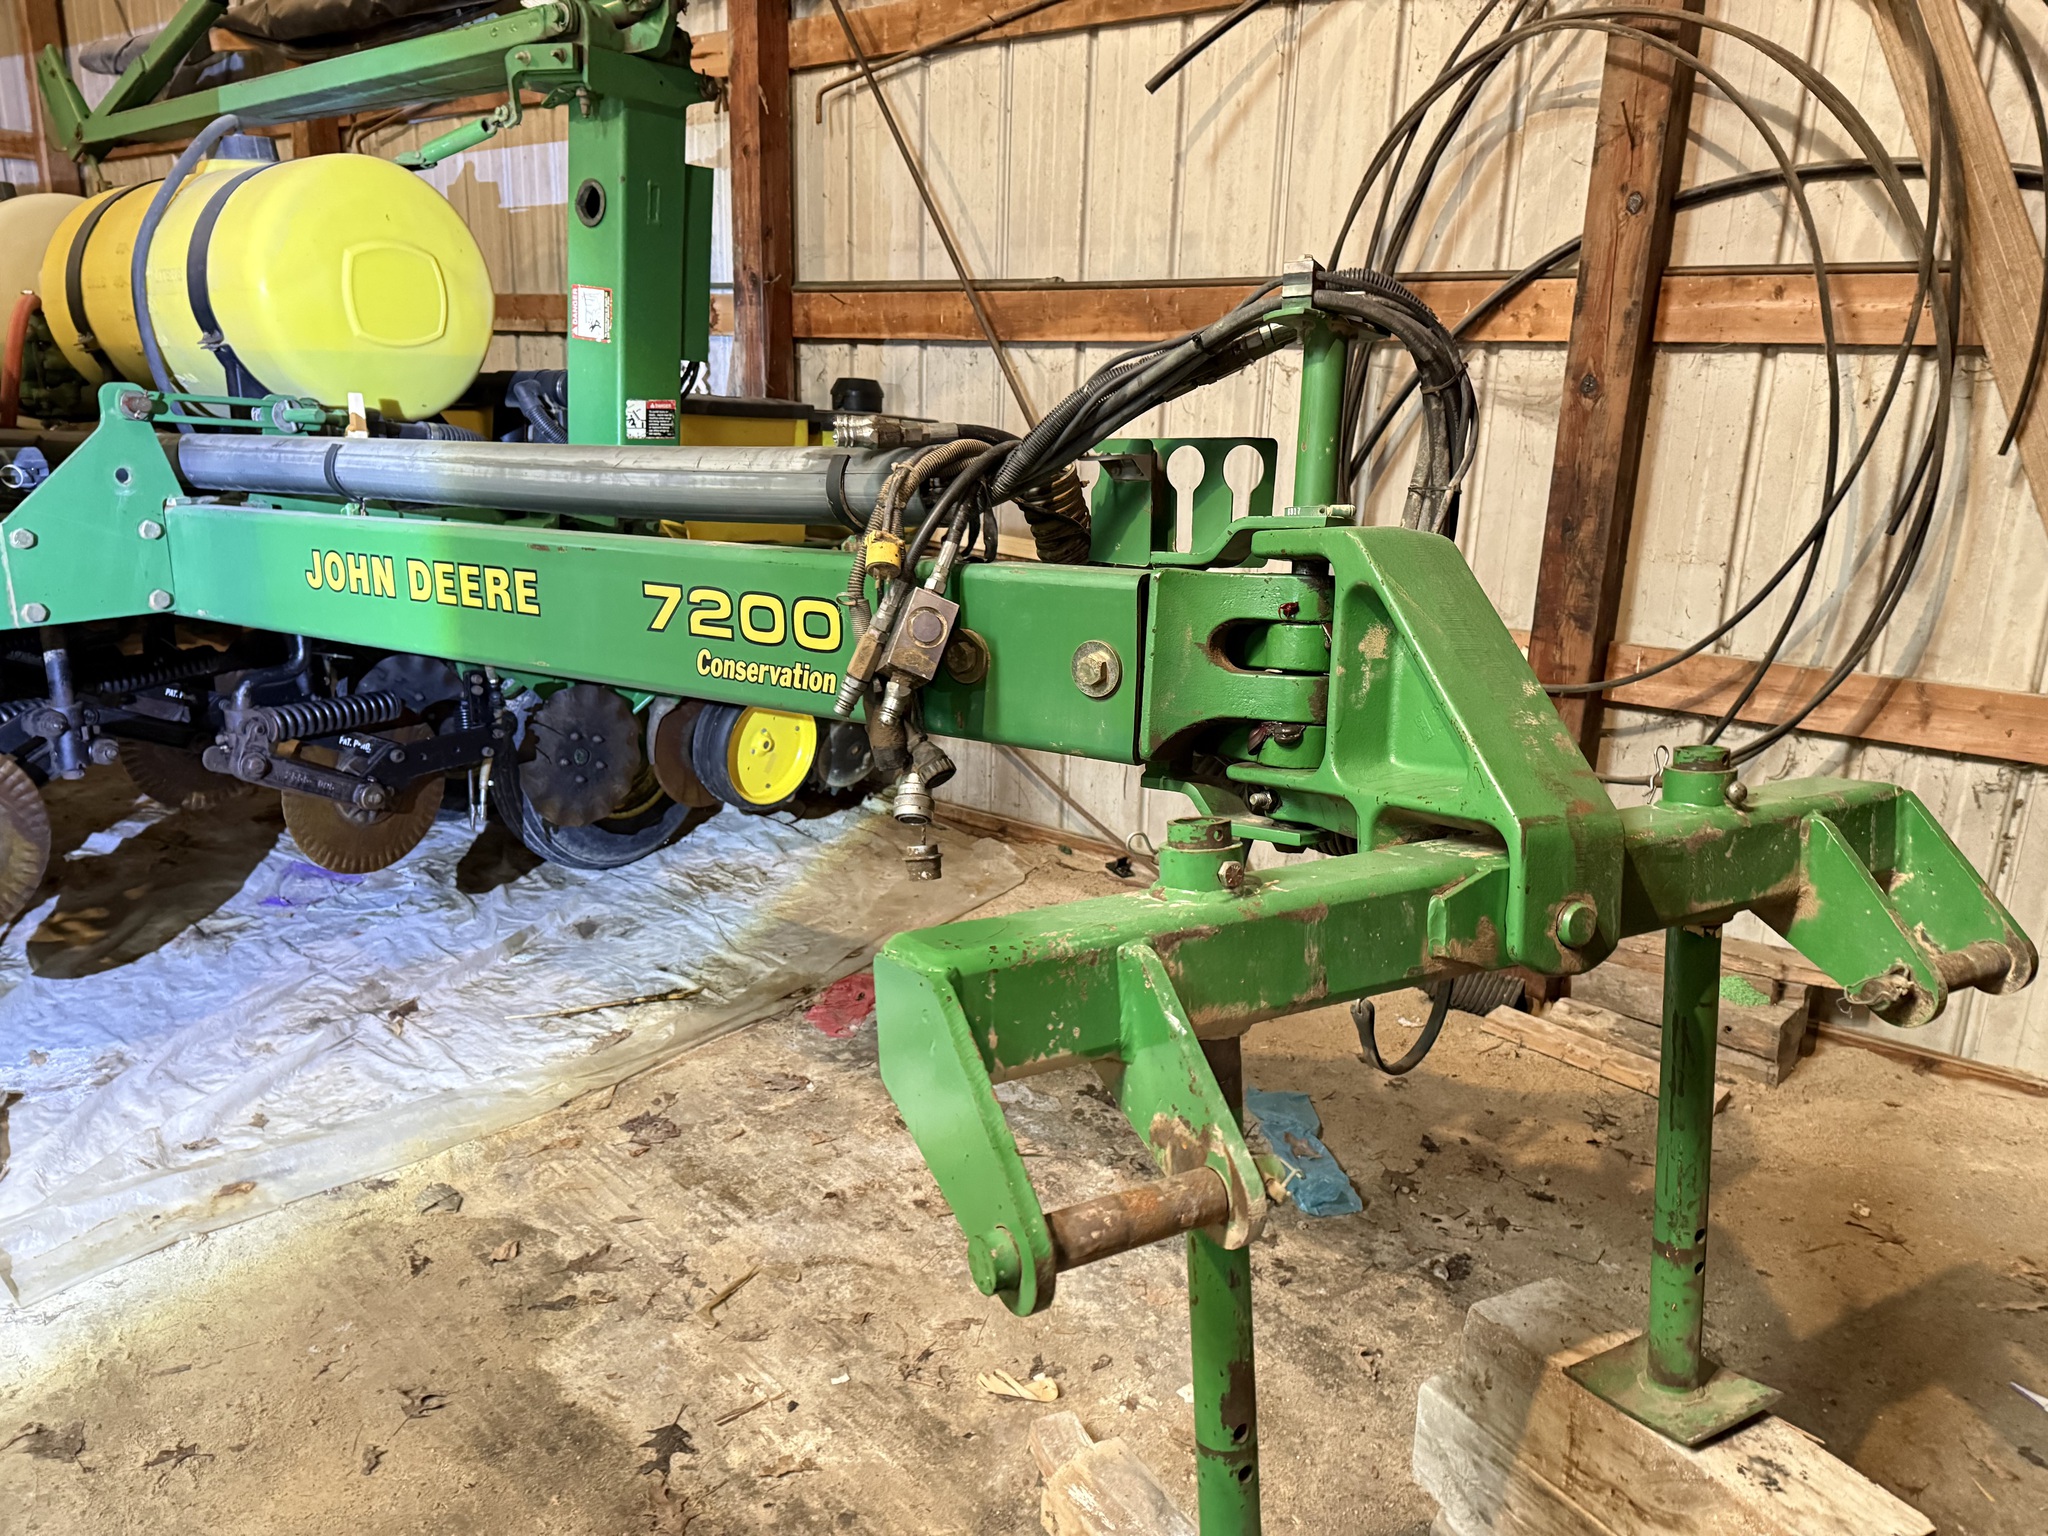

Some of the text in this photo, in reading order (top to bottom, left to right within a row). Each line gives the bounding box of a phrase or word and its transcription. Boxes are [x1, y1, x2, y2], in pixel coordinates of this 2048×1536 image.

[305, 549, 541, 617] JOHN DEERE
[642, 580, 844, 653] 7200
[165, 687, 178, 698] PAT.
[696, 648, 837, 695] Conservation
